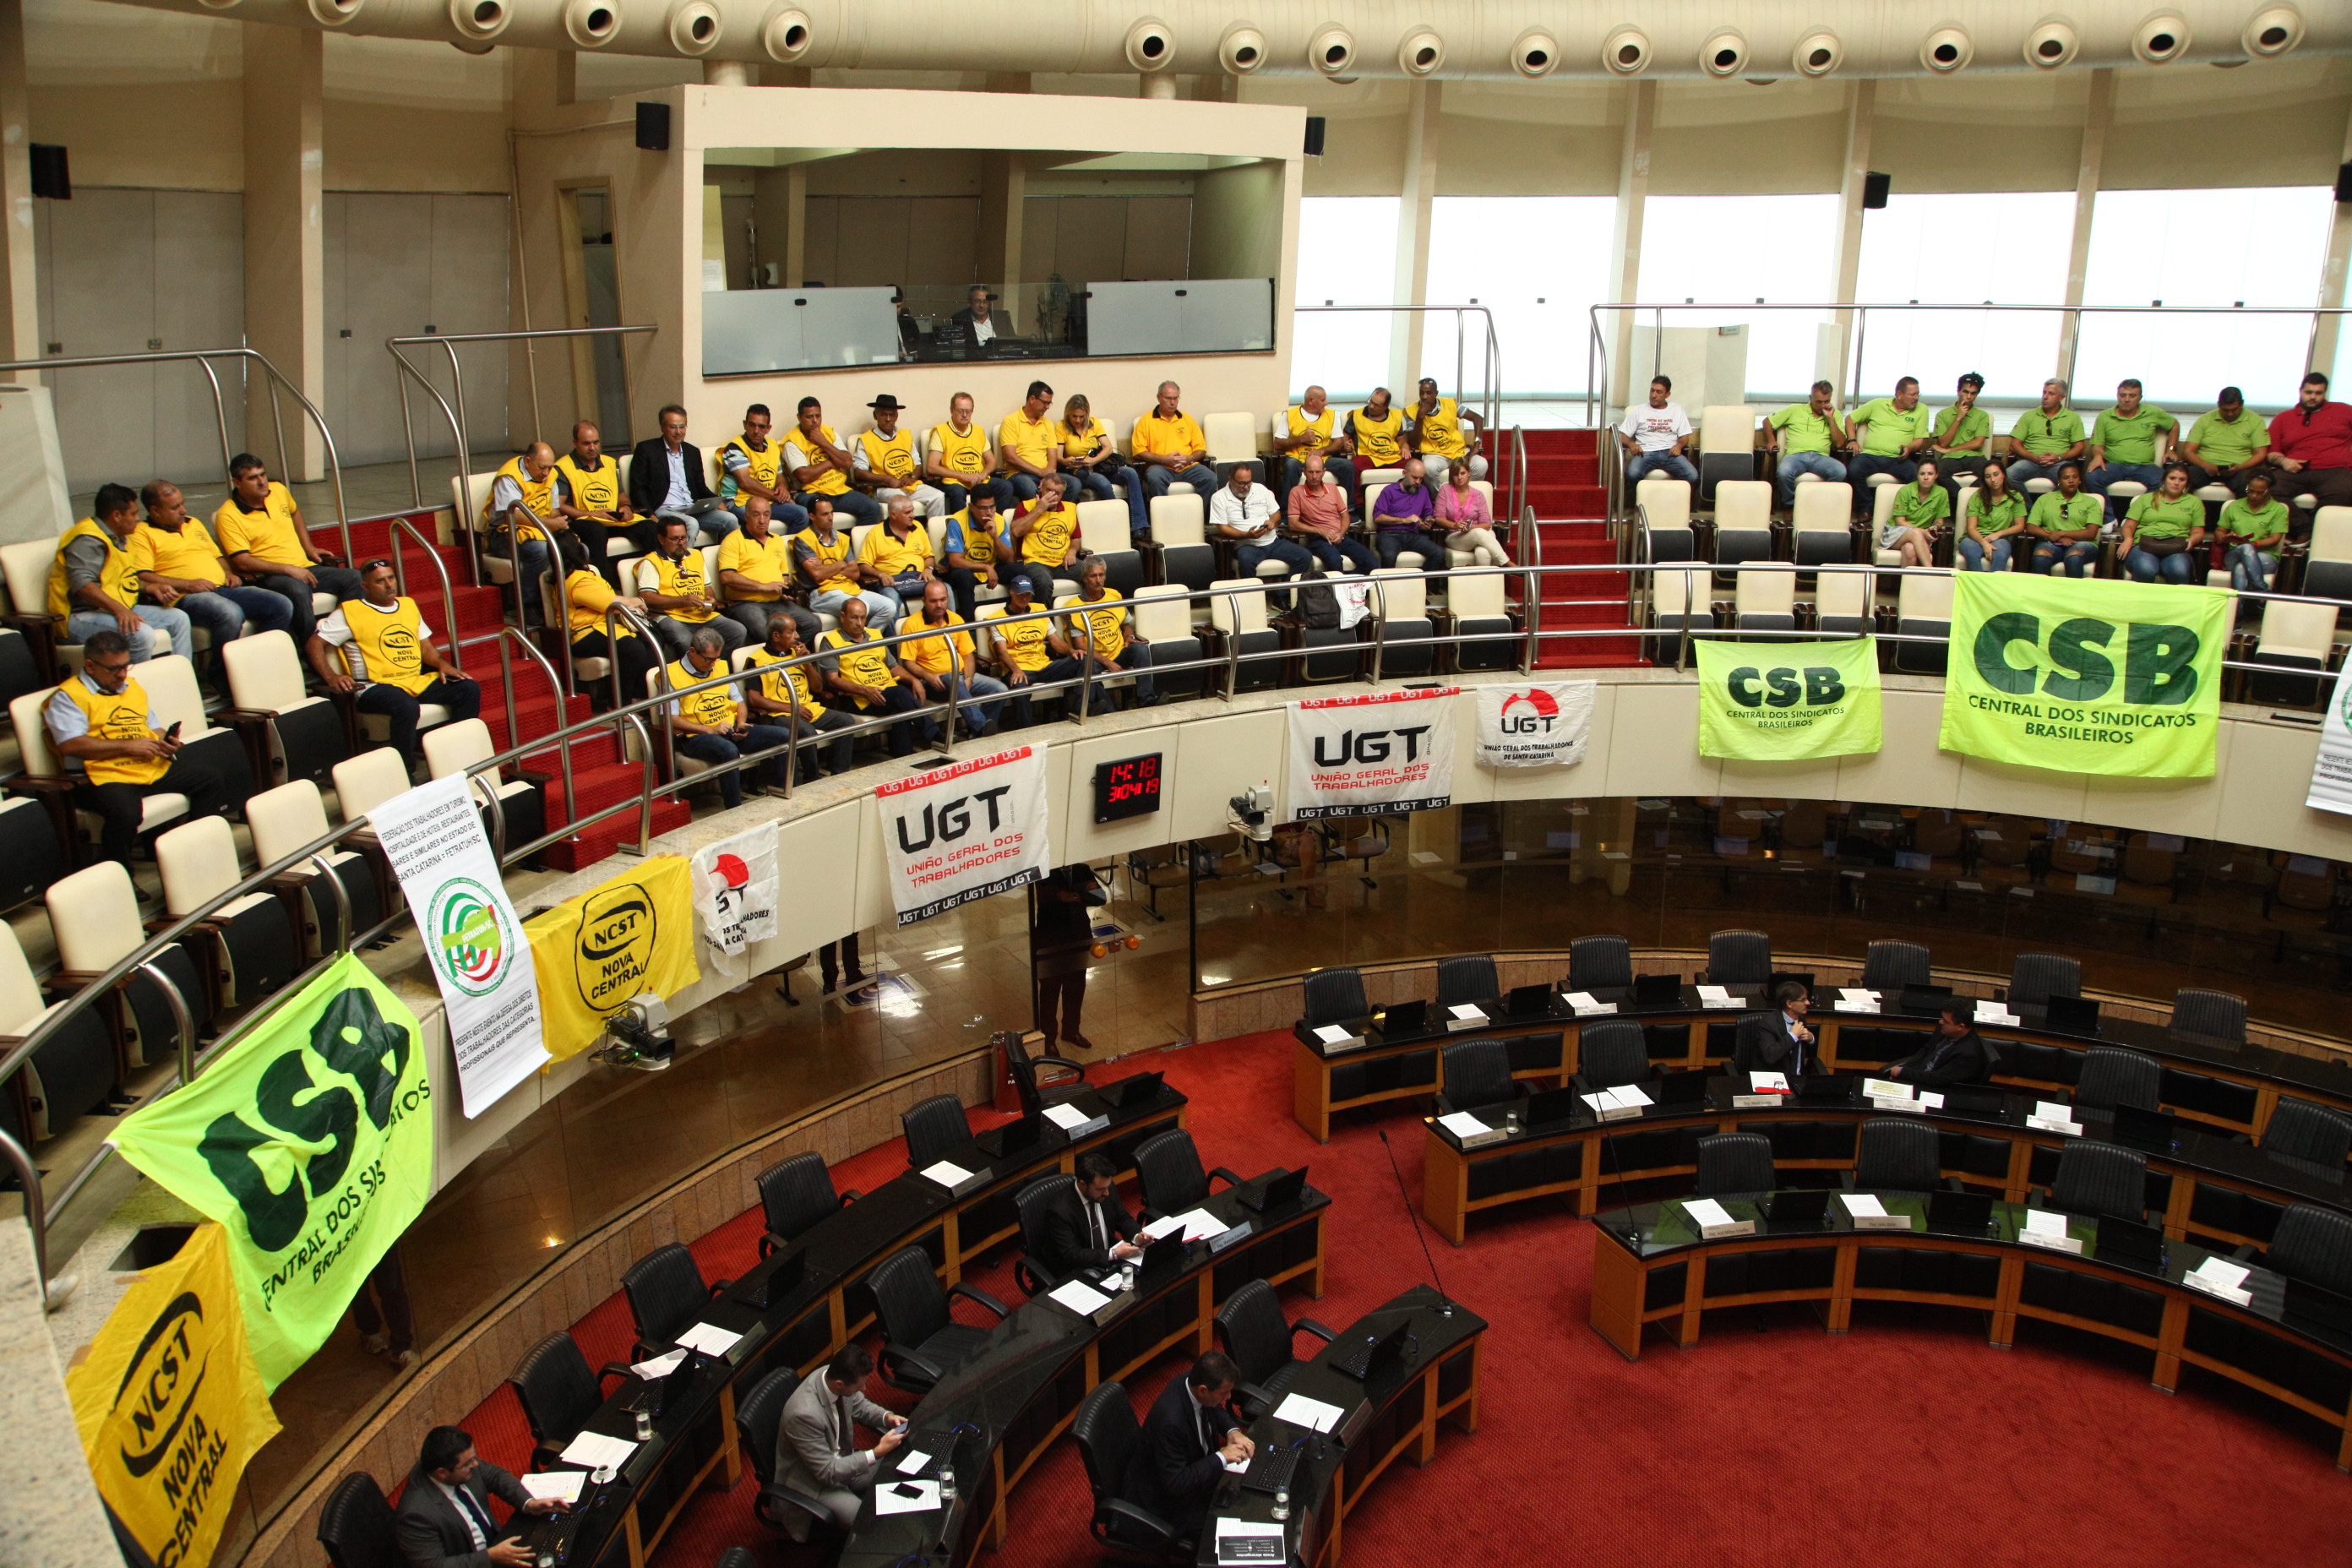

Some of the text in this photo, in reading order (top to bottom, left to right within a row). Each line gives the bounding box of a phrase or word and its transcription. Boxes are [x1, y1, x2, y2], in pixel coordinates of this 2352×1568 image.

[889, 457, 905, 466] NCST
[1092, 619, 1110, 629] NCST
[1974, 612, 2200, 705] CSB
[1337, 696, 1360, 705] UGT
[1369, 693, 1392, 702] UGT
[1401, 689, 1424, 700] UGT
[1728, 667, 1845, 707] CSB
[1500, 716, 1558, 733] UGT
[1727, 710, 1766, 718] CENTRAL
[1791, 707, 1844, 718] SINDICATOS
[1758, 720, 1813, 728] BRASILEIROS
[1968, 694, 2197, 728] CENTRAL DOS SINDICATOS
[1315, 725, 1432, 767] UGT
[1533, 741, 1573, 750] TRABALHADORES
[2025, 722, 2134, 744] BRASILEIROS
[884, 749, 1022, 792] UGT UGT UGT UGT UGT UGT
[1311, 763, 1429, 782] UNIÃO GERAL DOS
[1314, 772, 1426, 791] TRABALHADORES
[405, 819, 414, 831] DOS
[412, 806, 444, 828] TRABALHADORES
[444, 803, 451, 813] EM
[896, 784, 1012, 854] UGT
[1299, 797, 1448, 818] UGT UGT UGT UGT UGT
[387, 836, 417, 855] HOSPITALIDADE
[392, 821, 476, 868] BARES E SIMILARES NO ESTADO DE
[396, 867, 416, 883] SANTA
[415, 854, 443, 874] CATARINA
[445, 834, 482, 858] FETRATUH/SC
[906, 833, 1024, 875] UNIÃO GERAL DOS
[911, 847, 1021, 889] TRABALHADORES
[899, 871, 1032, 925] UGT UGT UGT UGT UGT UGT
[593, 912, 637, 948] NCST
[591, 962, 645, 1000] CENTRAL
[602, 951, 634, 979] NOVA
[455, 1031, 473, 1048] PRESENTE
[471, 1022, 483, 1036] NESTE
[483, 1015, 497, 1031] EVENTO
[458, 1002, 534, 1062] DOS TRABALHADORES DAS CATEGORIAS
[460, 1015, 536, 1075] PROFISSIONAIS QUE REPRESENTA.
[196, 987, 411, 1252] CSB
[326, 1186, 361, 1235] DOS
[132, 1319, 191, 1450] NCST
[162, 1413, 207, 1511] NOVA
[155, 1429, 228, 1568] CENTRAL
